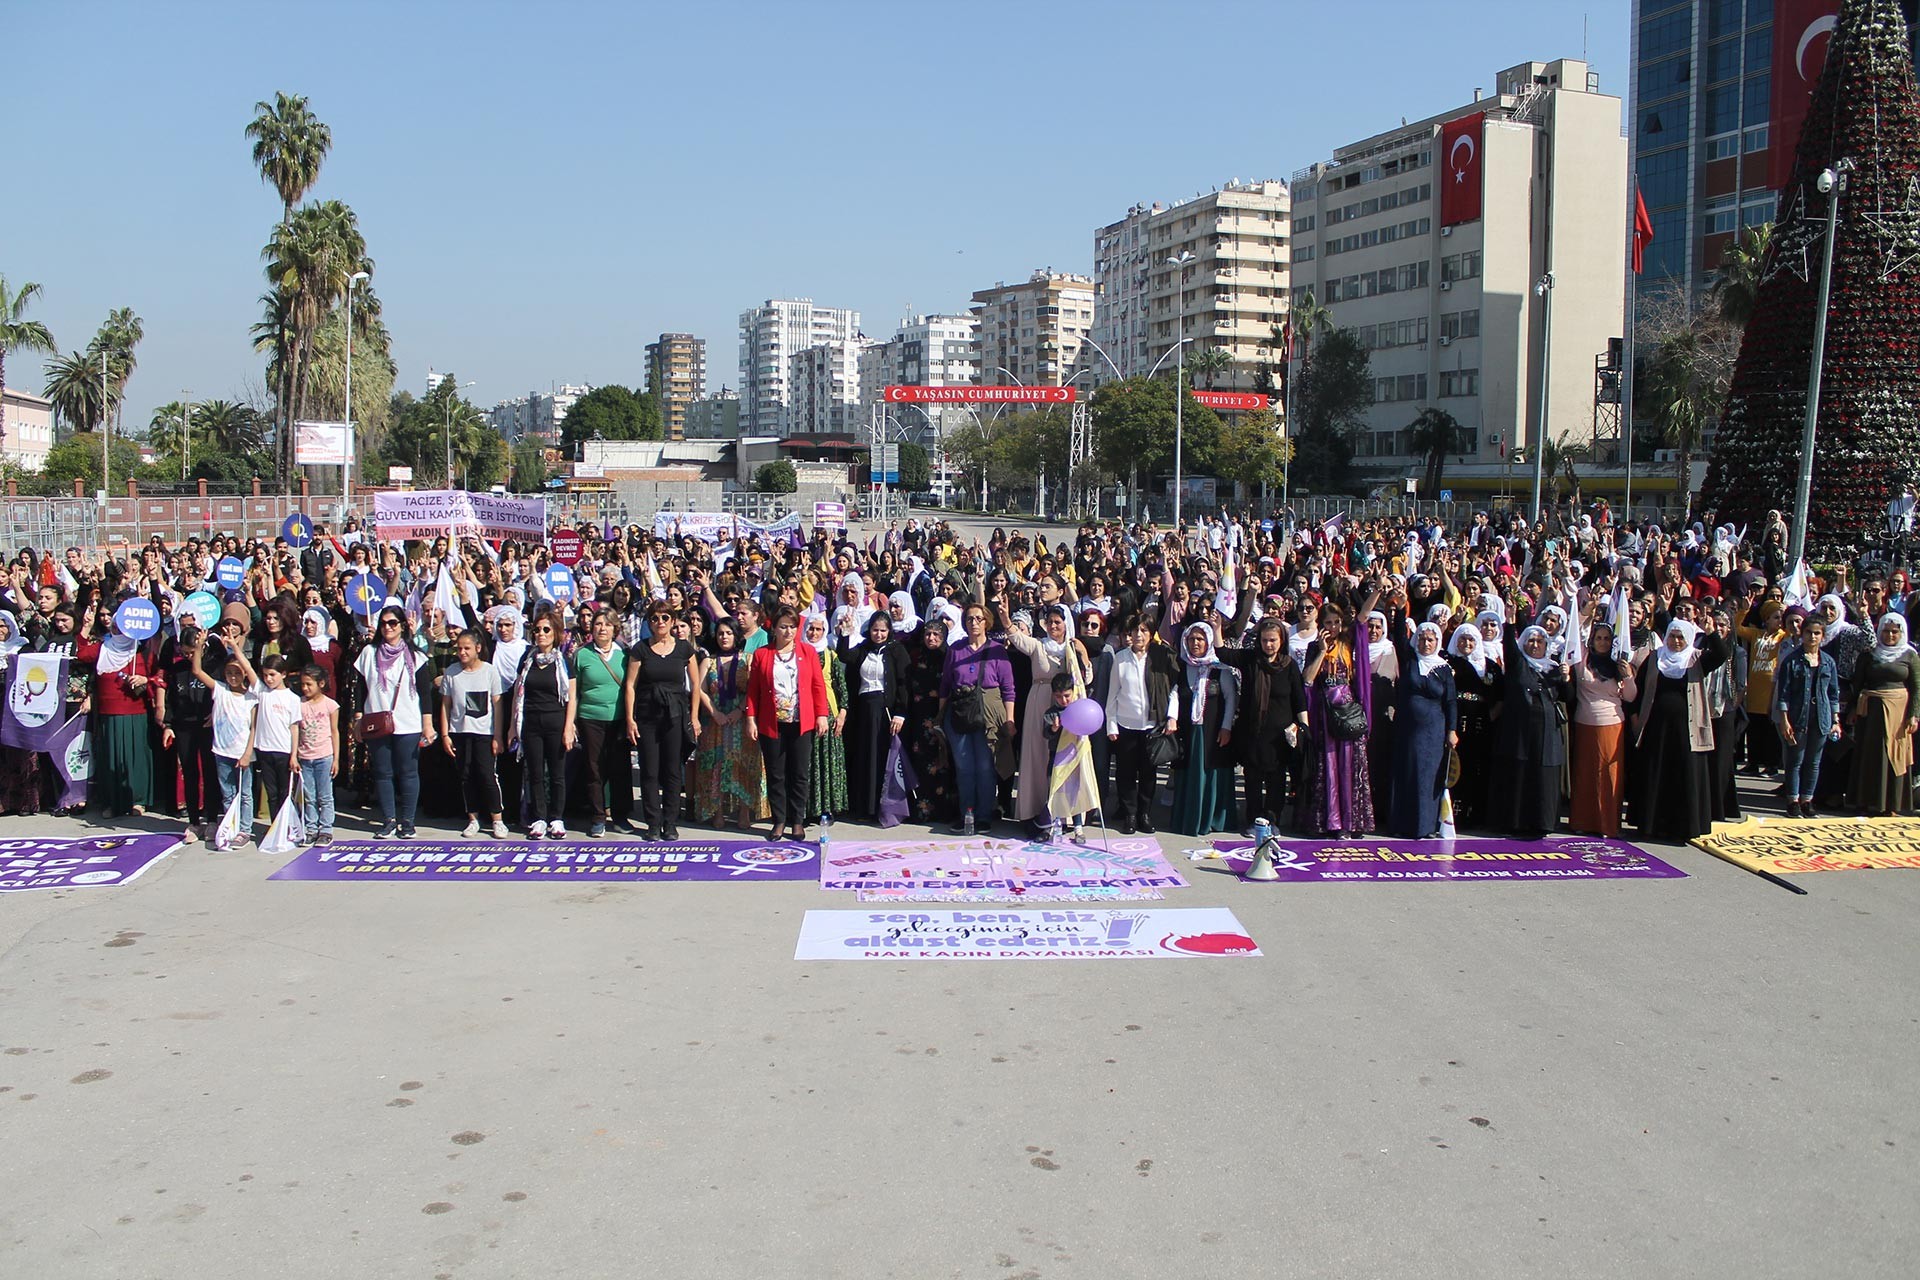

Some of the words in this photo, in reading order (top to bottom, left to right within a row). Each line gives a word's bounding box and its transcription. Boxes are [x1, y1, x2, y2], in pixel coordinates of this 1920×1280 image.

[914, 389, 964, 401] YAŞASIN
[968, 387, 1048, 399] CUMHURİYET
[1193, 394, 1243, 405] HURİYET
[404, 496, 446, 507] TACİZE,
[376, 508, 426, 521] GÜVENLİ
[411, 527, 440, 538] KADIN
[123, 607, 155, 619] ADIM
[123, 618, 152, 630] ŞULE
[318, 852, 502, 864] YAŞAMAK
[1402, 851, 1572, 861] kadınım
[337, 865, 428, 873] ADANA
[436, 865, 518, 873] KADIN
[524, 865, 679, 873] PLATFORMU
[1377, 871, 1446, 879] ADANA
[1448, 870, 1513, 878] KADIN
[825, 880, 915, 889] KADIN
[868, 913, 940, 924] sen,
[952, 911, 1031, 924] ben,
[1041, 911, 1099, 923] biz
[844, 935, 961, 947] altüst
[999, 949, 1155, 958] DAYANIŞMASI
